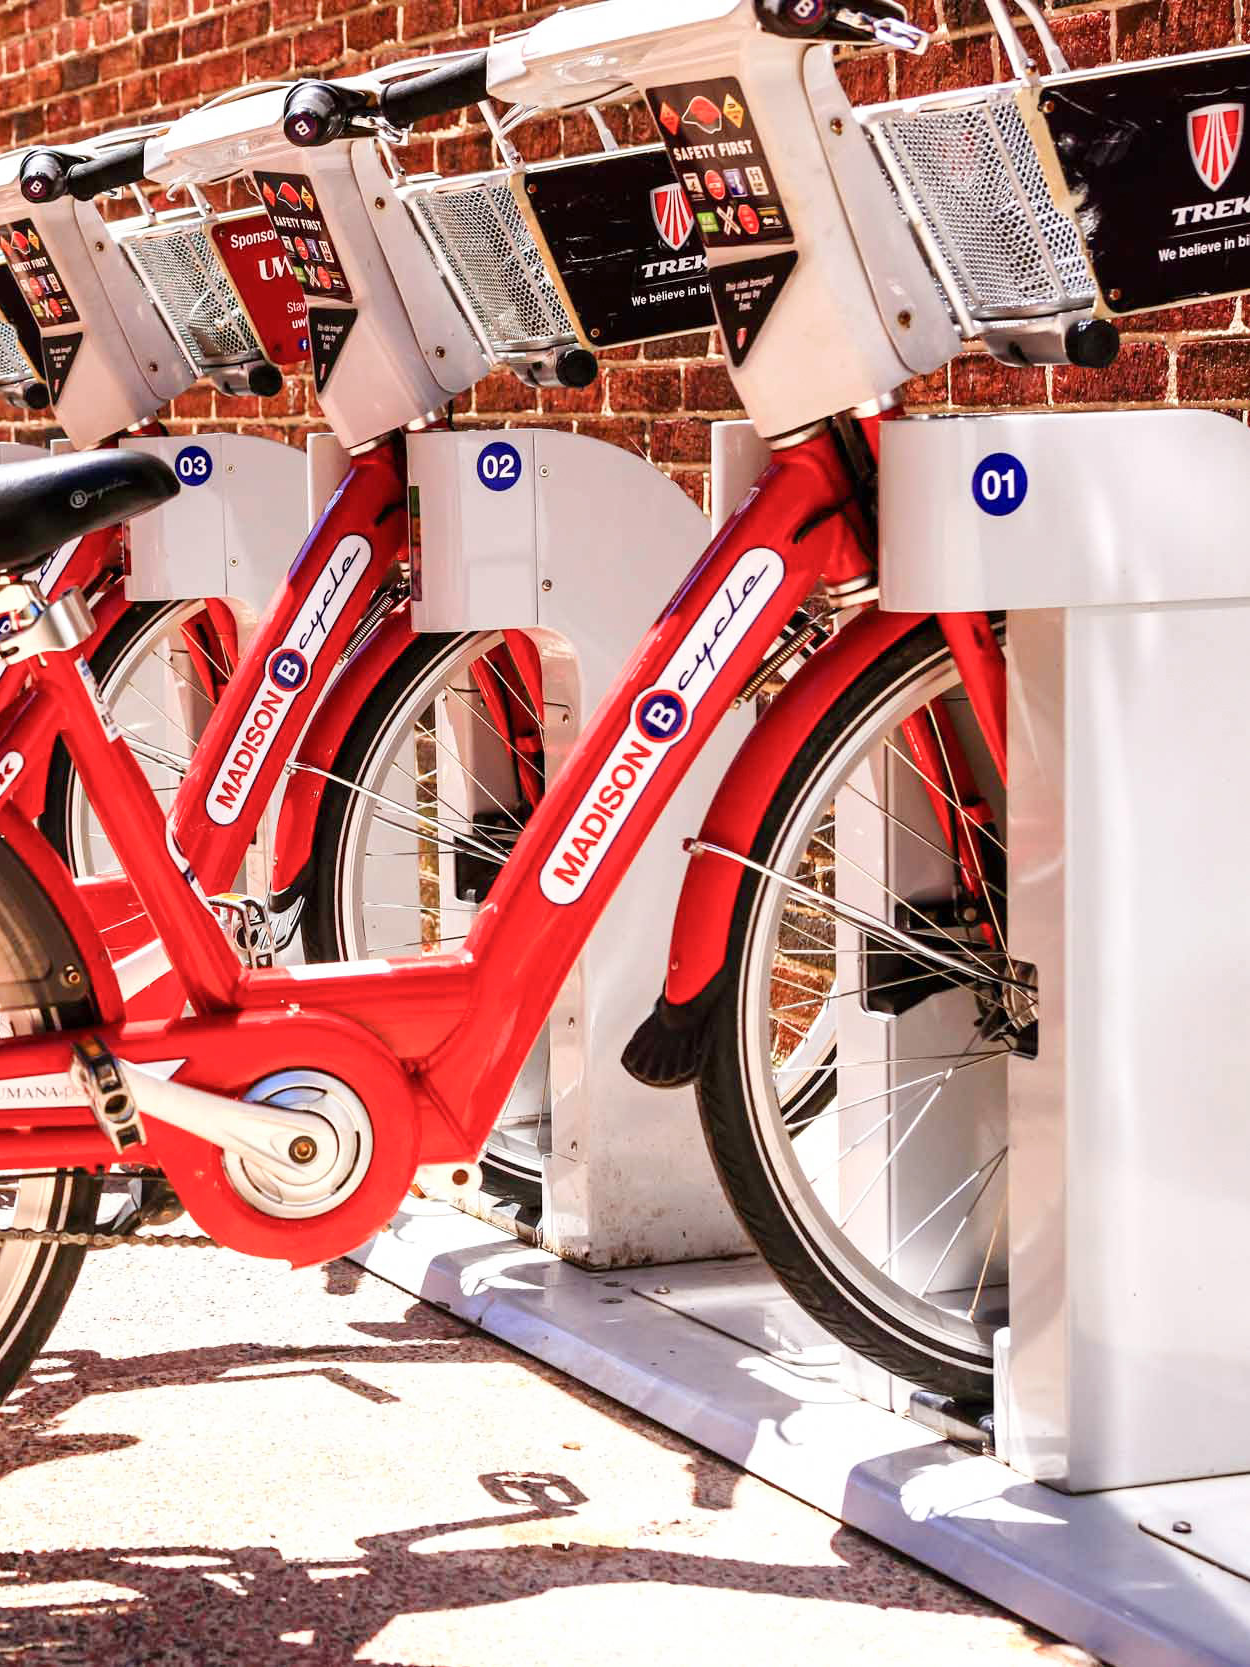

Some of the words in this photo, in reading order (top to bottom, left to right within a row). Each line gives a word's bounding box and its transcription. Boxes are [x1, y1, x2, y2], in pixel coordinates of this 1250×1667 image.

[295, 120, 311, 136] B
[673, 143, 717, 162] SAFETY
[718, 140, 753, 158] FIRST
[1171, 195, 1250, 226] TREK
[273, 216, 300, 229] SAFETY
[301, 219, 322, 231] FIRST
[1158, 248, 1177, 262] We
[1179, 241, 1222, 259] believe
[1224, 237, 1235, 250] in
[641, 255, 708, 278] TREK
[287, 301, 305, 314] Stay
[631, 293, 647, 307] We
[649, 290, 685, 303] believe
[687, 286, 697, 296] in
[180, 455, 207, 477] 03
[483, 454, 515, 479] 02
[981, 468, 1015, 501] 01
[215, 690, 284, 809] MADISON
[276, 658, 299, 683] B
[299, 547, 360, 650] cycle
[553, 739, 653, 886] MADISON
[645, 701, 678, 733] B
[678, 565, 768, 691] cycle
